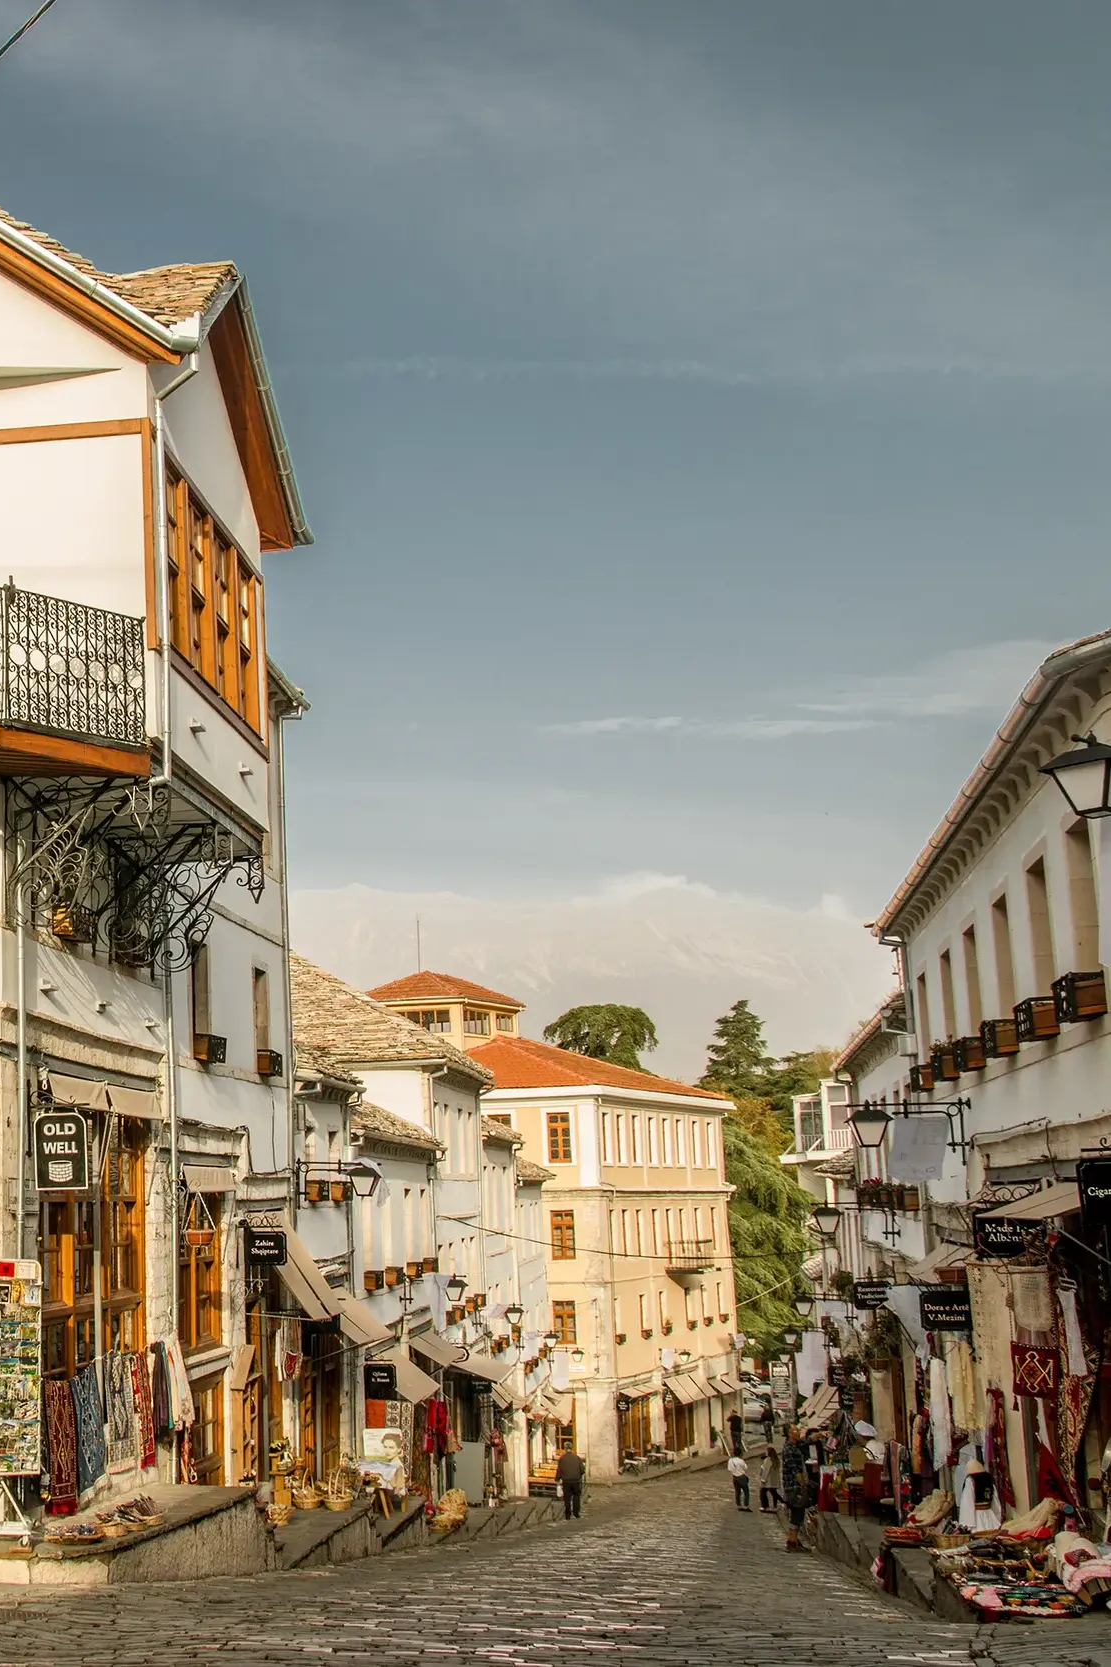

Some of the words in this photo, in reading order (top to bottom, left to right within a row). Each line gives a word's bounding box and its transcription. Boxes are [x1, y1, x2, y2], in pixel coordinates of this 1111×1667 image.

[43, 1123, 76, 1136] OLD
[43, 1141, 78, 1154] WELL
[251, 1247, 279, 1256] Shqiptare
